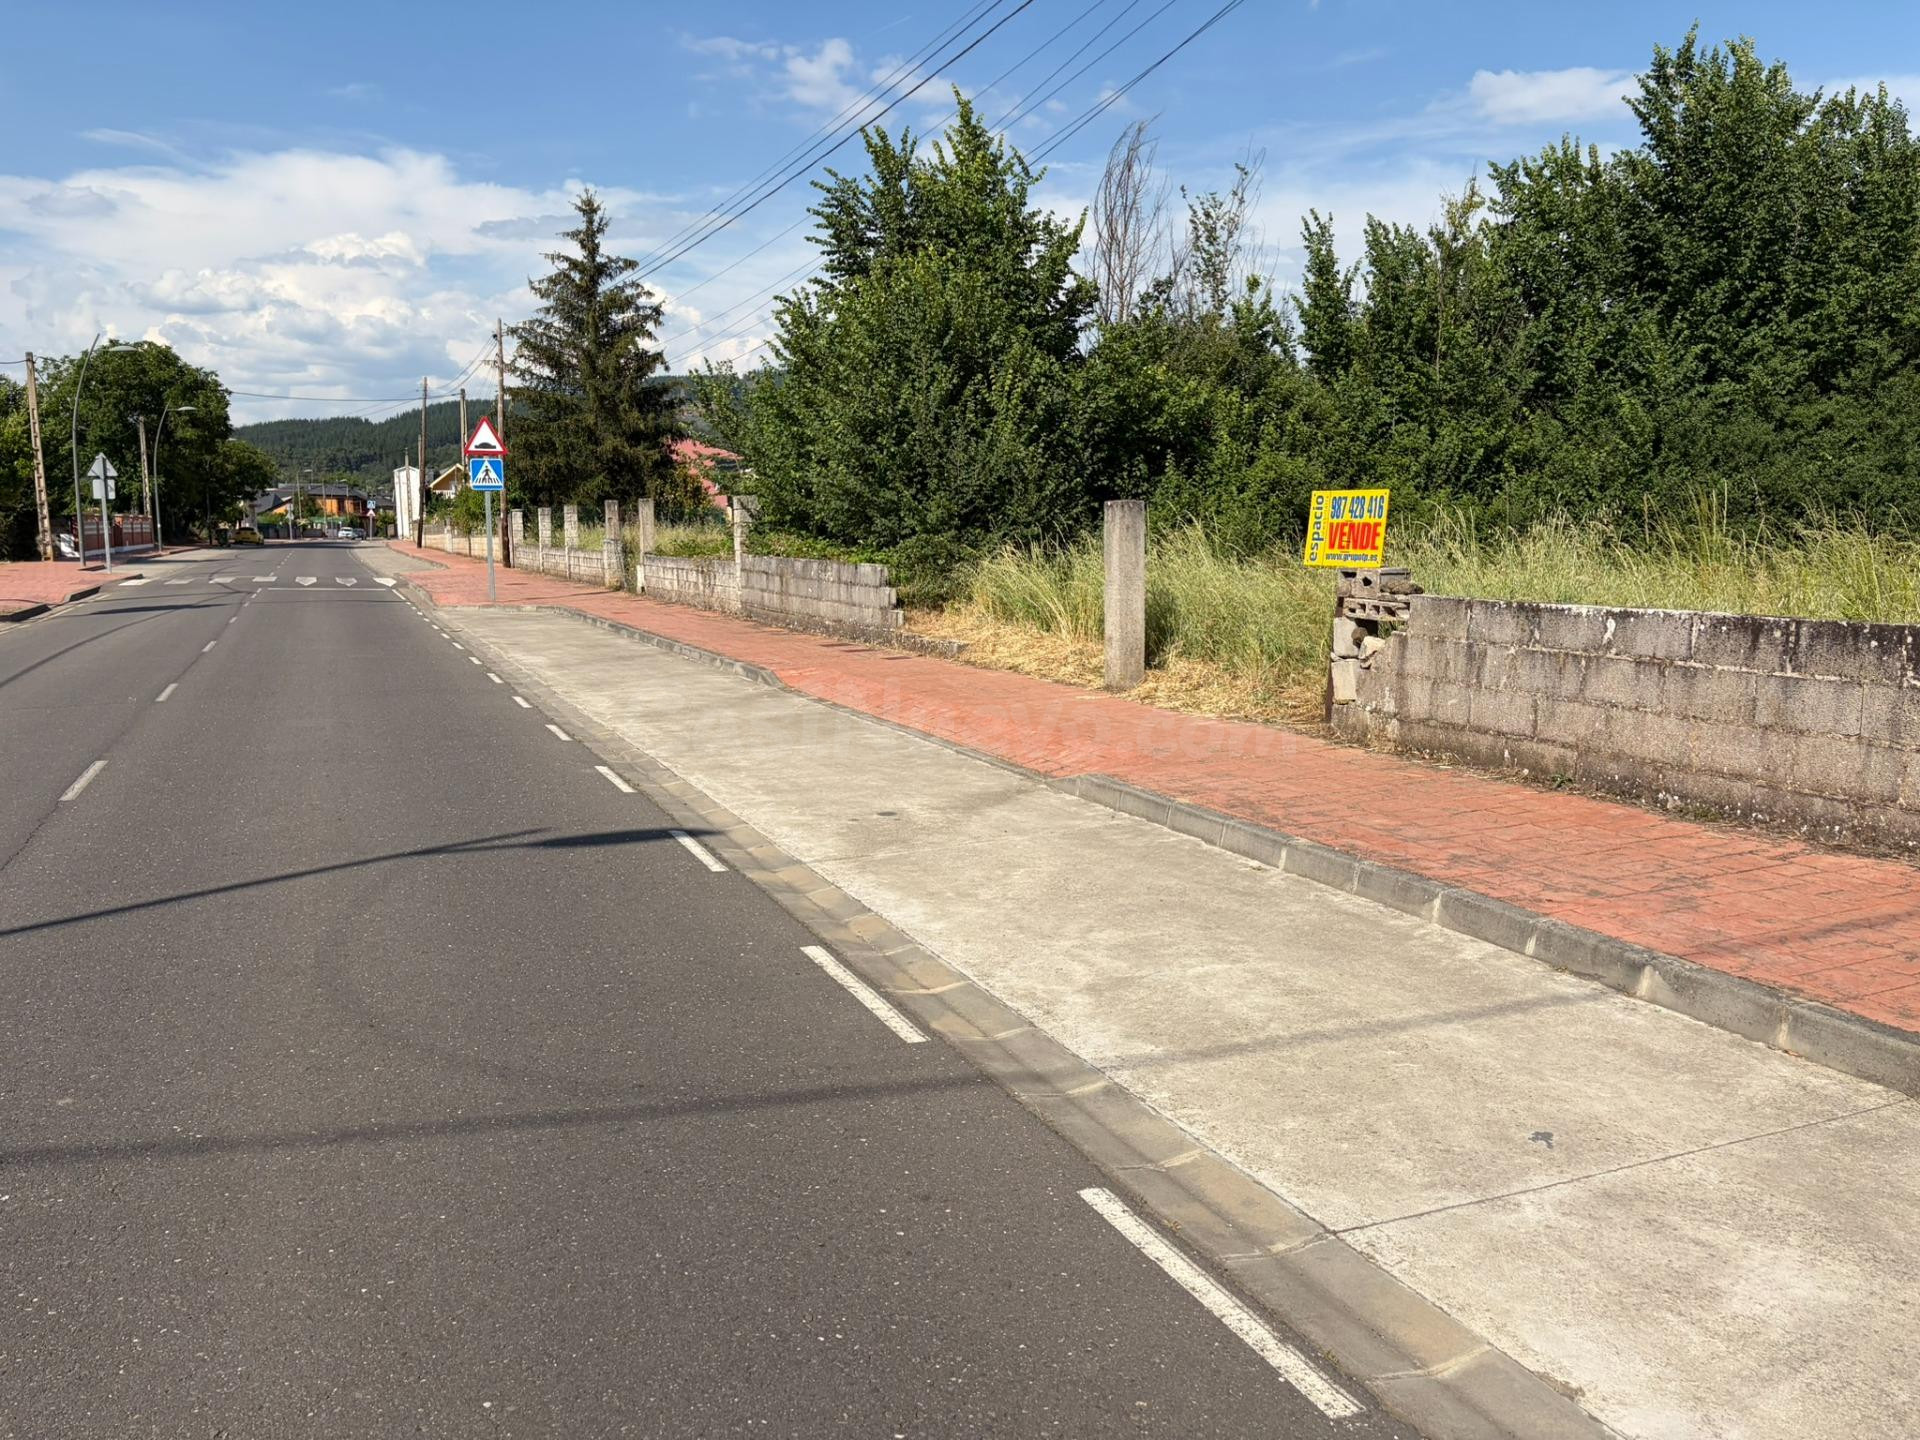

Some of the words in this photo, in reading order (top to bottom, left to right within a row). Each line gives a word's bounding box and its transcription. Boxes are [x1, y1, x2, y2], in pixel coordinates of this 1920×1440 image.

[1330, 496, 1348, 519] 987
[1349, 495, 1366, 519] 428
[1367, 495, 1385, 519] 416
[1309, 495, 1325, 562] espacio
[1328, 521, 1382, 550] VENDE
